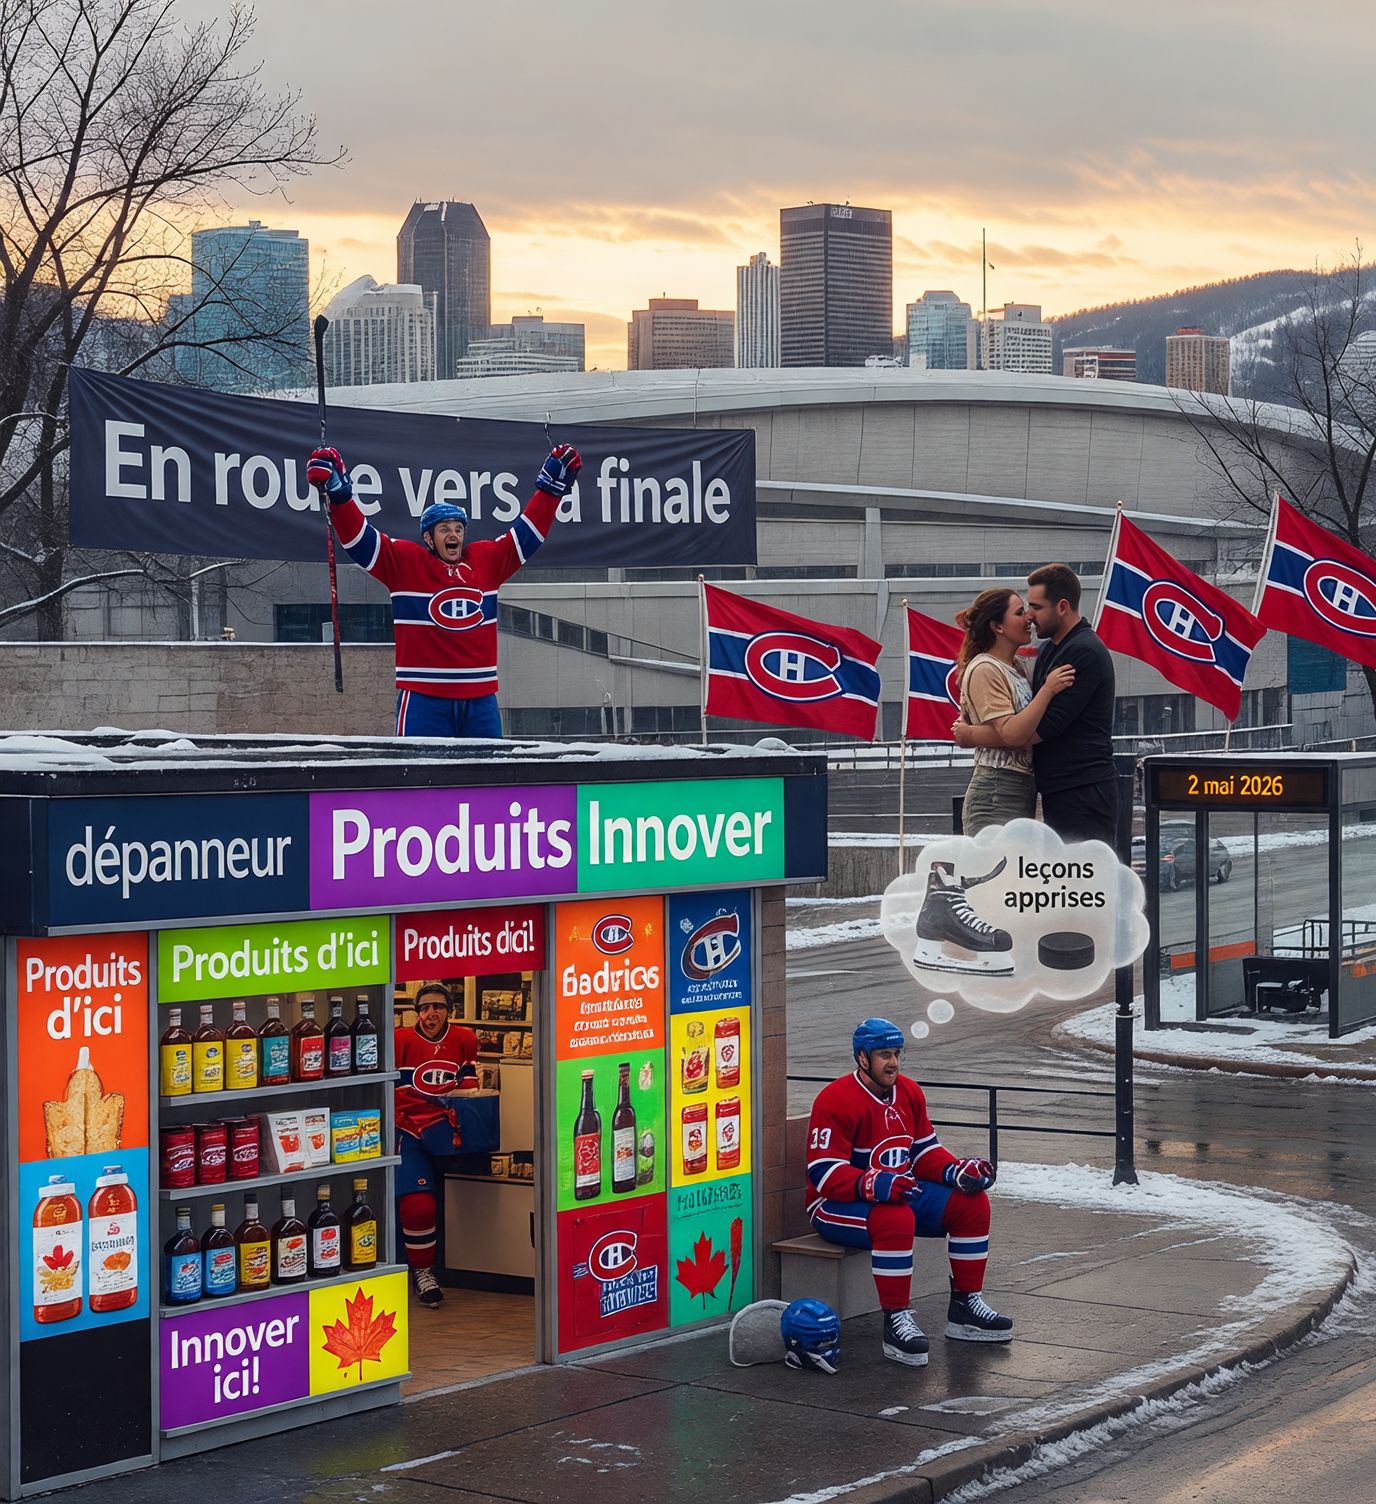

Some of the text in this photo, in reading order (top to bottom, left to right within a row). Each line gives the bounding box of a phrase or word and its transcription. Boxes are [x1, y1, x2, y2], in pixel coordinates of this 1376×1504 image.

[105, 419, 191, 503] En
[214, 452, 383, 516] roue
[398, 467, 521, 522] vers
[596, 456, 731, 524] finale
[1188, 774, 1284, 796] 2 mai 2026
[332, 801, 572, 880] Produits
[589, 800, 772, 865] Innover
[65, 825, 292, 899] dépanneur
[173, 930, 379, 983] Produits d'ici
[404, 924, 493, 962] Produits
[26, 952, 142, 993] Produits
[47, 992, 122, 1040] d'ici
[171, 1315, 300, 1368] Innover
[213, 1356, 260, 1404] ici!
